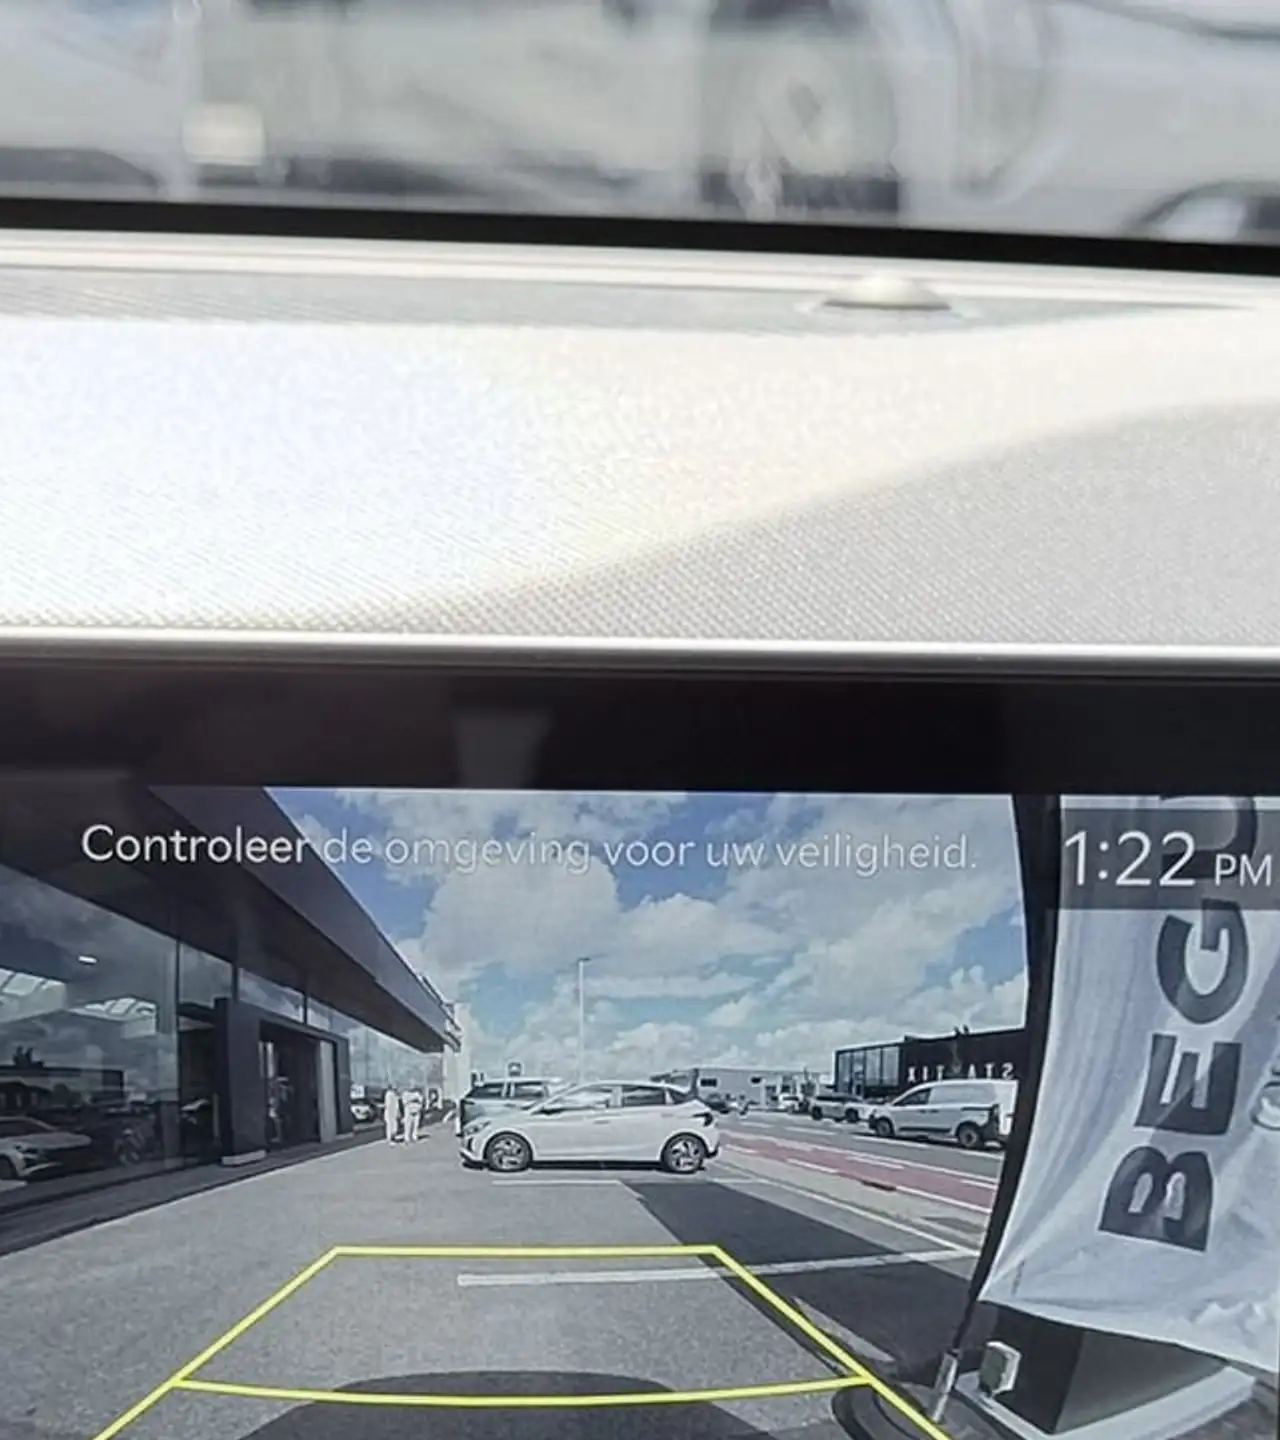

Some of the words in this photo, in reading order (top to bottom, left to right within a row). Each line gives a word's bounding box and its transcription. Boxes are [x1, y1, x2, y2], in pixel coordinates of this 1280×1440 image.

[81, 824, 308, 865] Controleer
[324, 826, 374, 865] de
[384, 831, 589, 875] omgeving
[602, 837, 696, 868] voor
[705, 838, 767, 868] uw
[775, 832, 978, 877] veiligheid.
[1063, 829, 1196, 888] 1:22
[1214, 854, 1273, 888] PM
